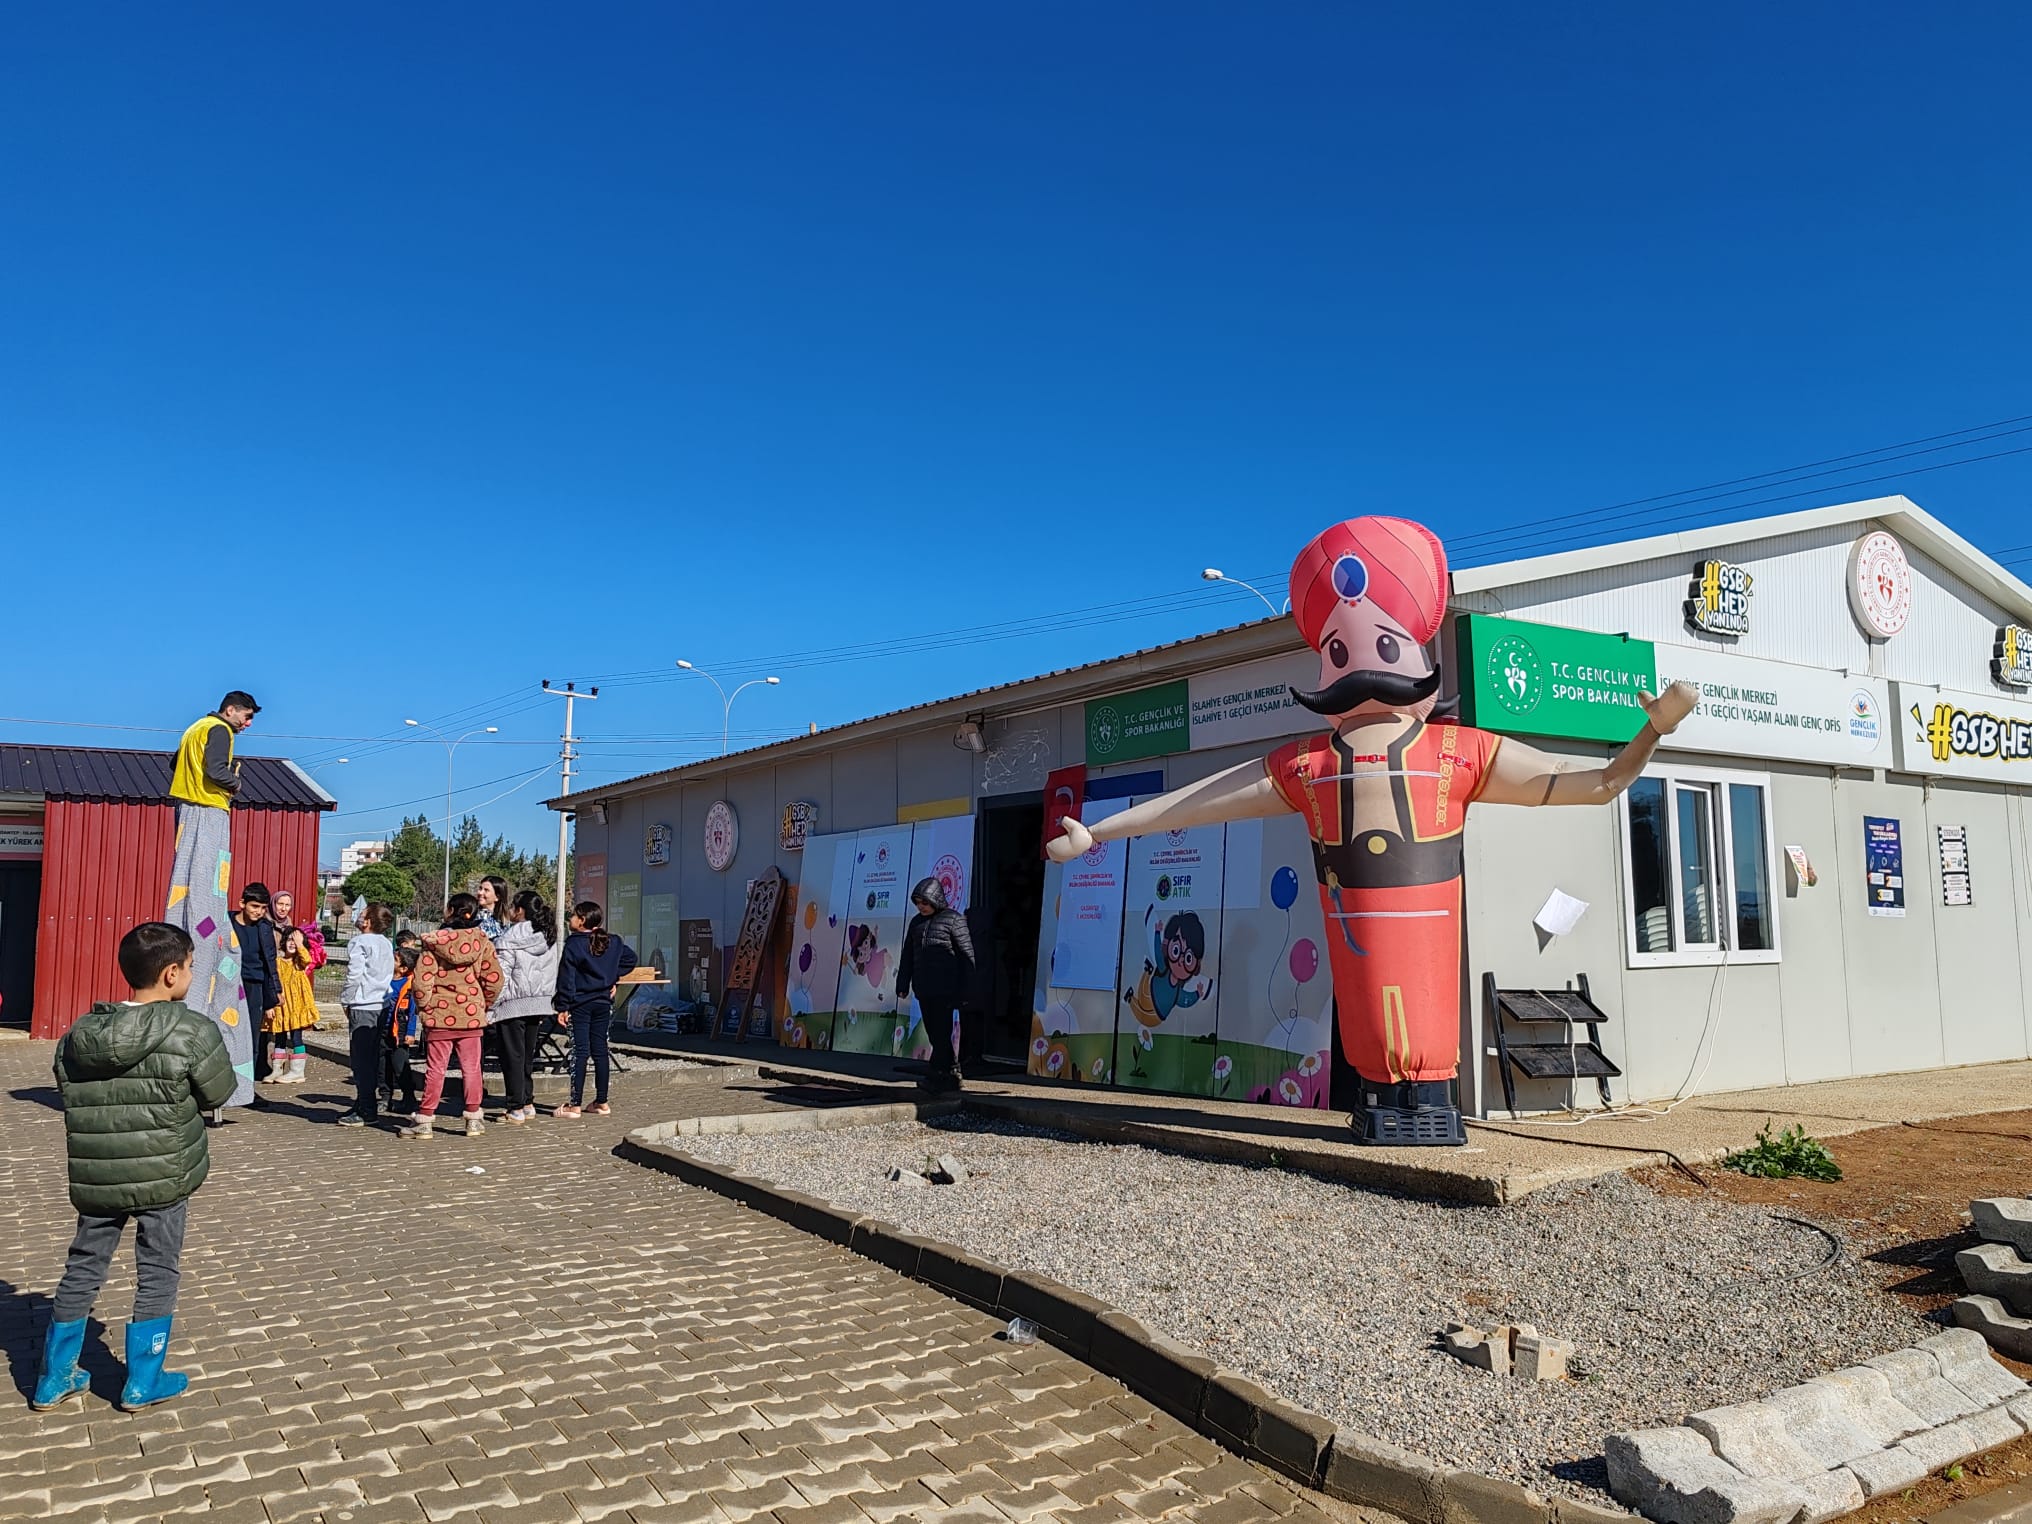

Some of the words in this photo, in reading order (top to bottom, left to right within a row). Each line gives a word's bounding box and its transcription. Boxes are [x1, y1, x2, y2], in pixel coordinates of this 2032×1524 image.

[1720, 590, 1748, 615] HEP
[1707, 611, 1749, 632] YANINDA
[1551, 662, 1574, 679] T.C.
[1577, 666, 1629, 687] GENÇLİK
[1633, 674, 1647, 688] VE
[1192, 696, 1221, 712] İSLAHİYE
[1223, 691, 1252, 707] GENÇLİK
[1254, 683, 1287, 700] MERKEZİ
[1553, 684, 1584, 701] SPOR
[1588, 690, 1644, 708] BAKANLI
[1703, 682, 1740, 702] GENÇLİK
[1742, 688, 1778, 706] MERKEZİ
[1124, 714, 1138, 725] T.C.
[1139, 708, 1172, 724] GENÇLİK
[1174, 704, 1184, 714] VE
[1192, 711, 1222, 725] İSLAHİYE
[1230, 705, 1252, 721] GEÇİCİ
[1254, 702, 1281, 716] YAŞAM
[1283, 697, 1300, 709] ALA
[1704, 704, 1709, 716] 1
[1711, 704, 1739, 719] GEÇİCİ
[1742, 708, 1772, 726] YAŞAM
[1774, 712, 1799, 727] ALANI
[1801, 715, 1822, 733] GENÇ
[1824, 718, 1841, 732] OFİS
[1124, 727, 1144, 738] SPOR
[1145, 717, 1185, 735] BAKANLIĞI
[1928, 705, 1998, 759] #GSB
[2000, 721, 2032, 759] HE
[8, 836, 32, 845] YÜREK
[1172, 886, 1191, 898] ATIK
[1173, 874, 1192, 886] SIFIR
